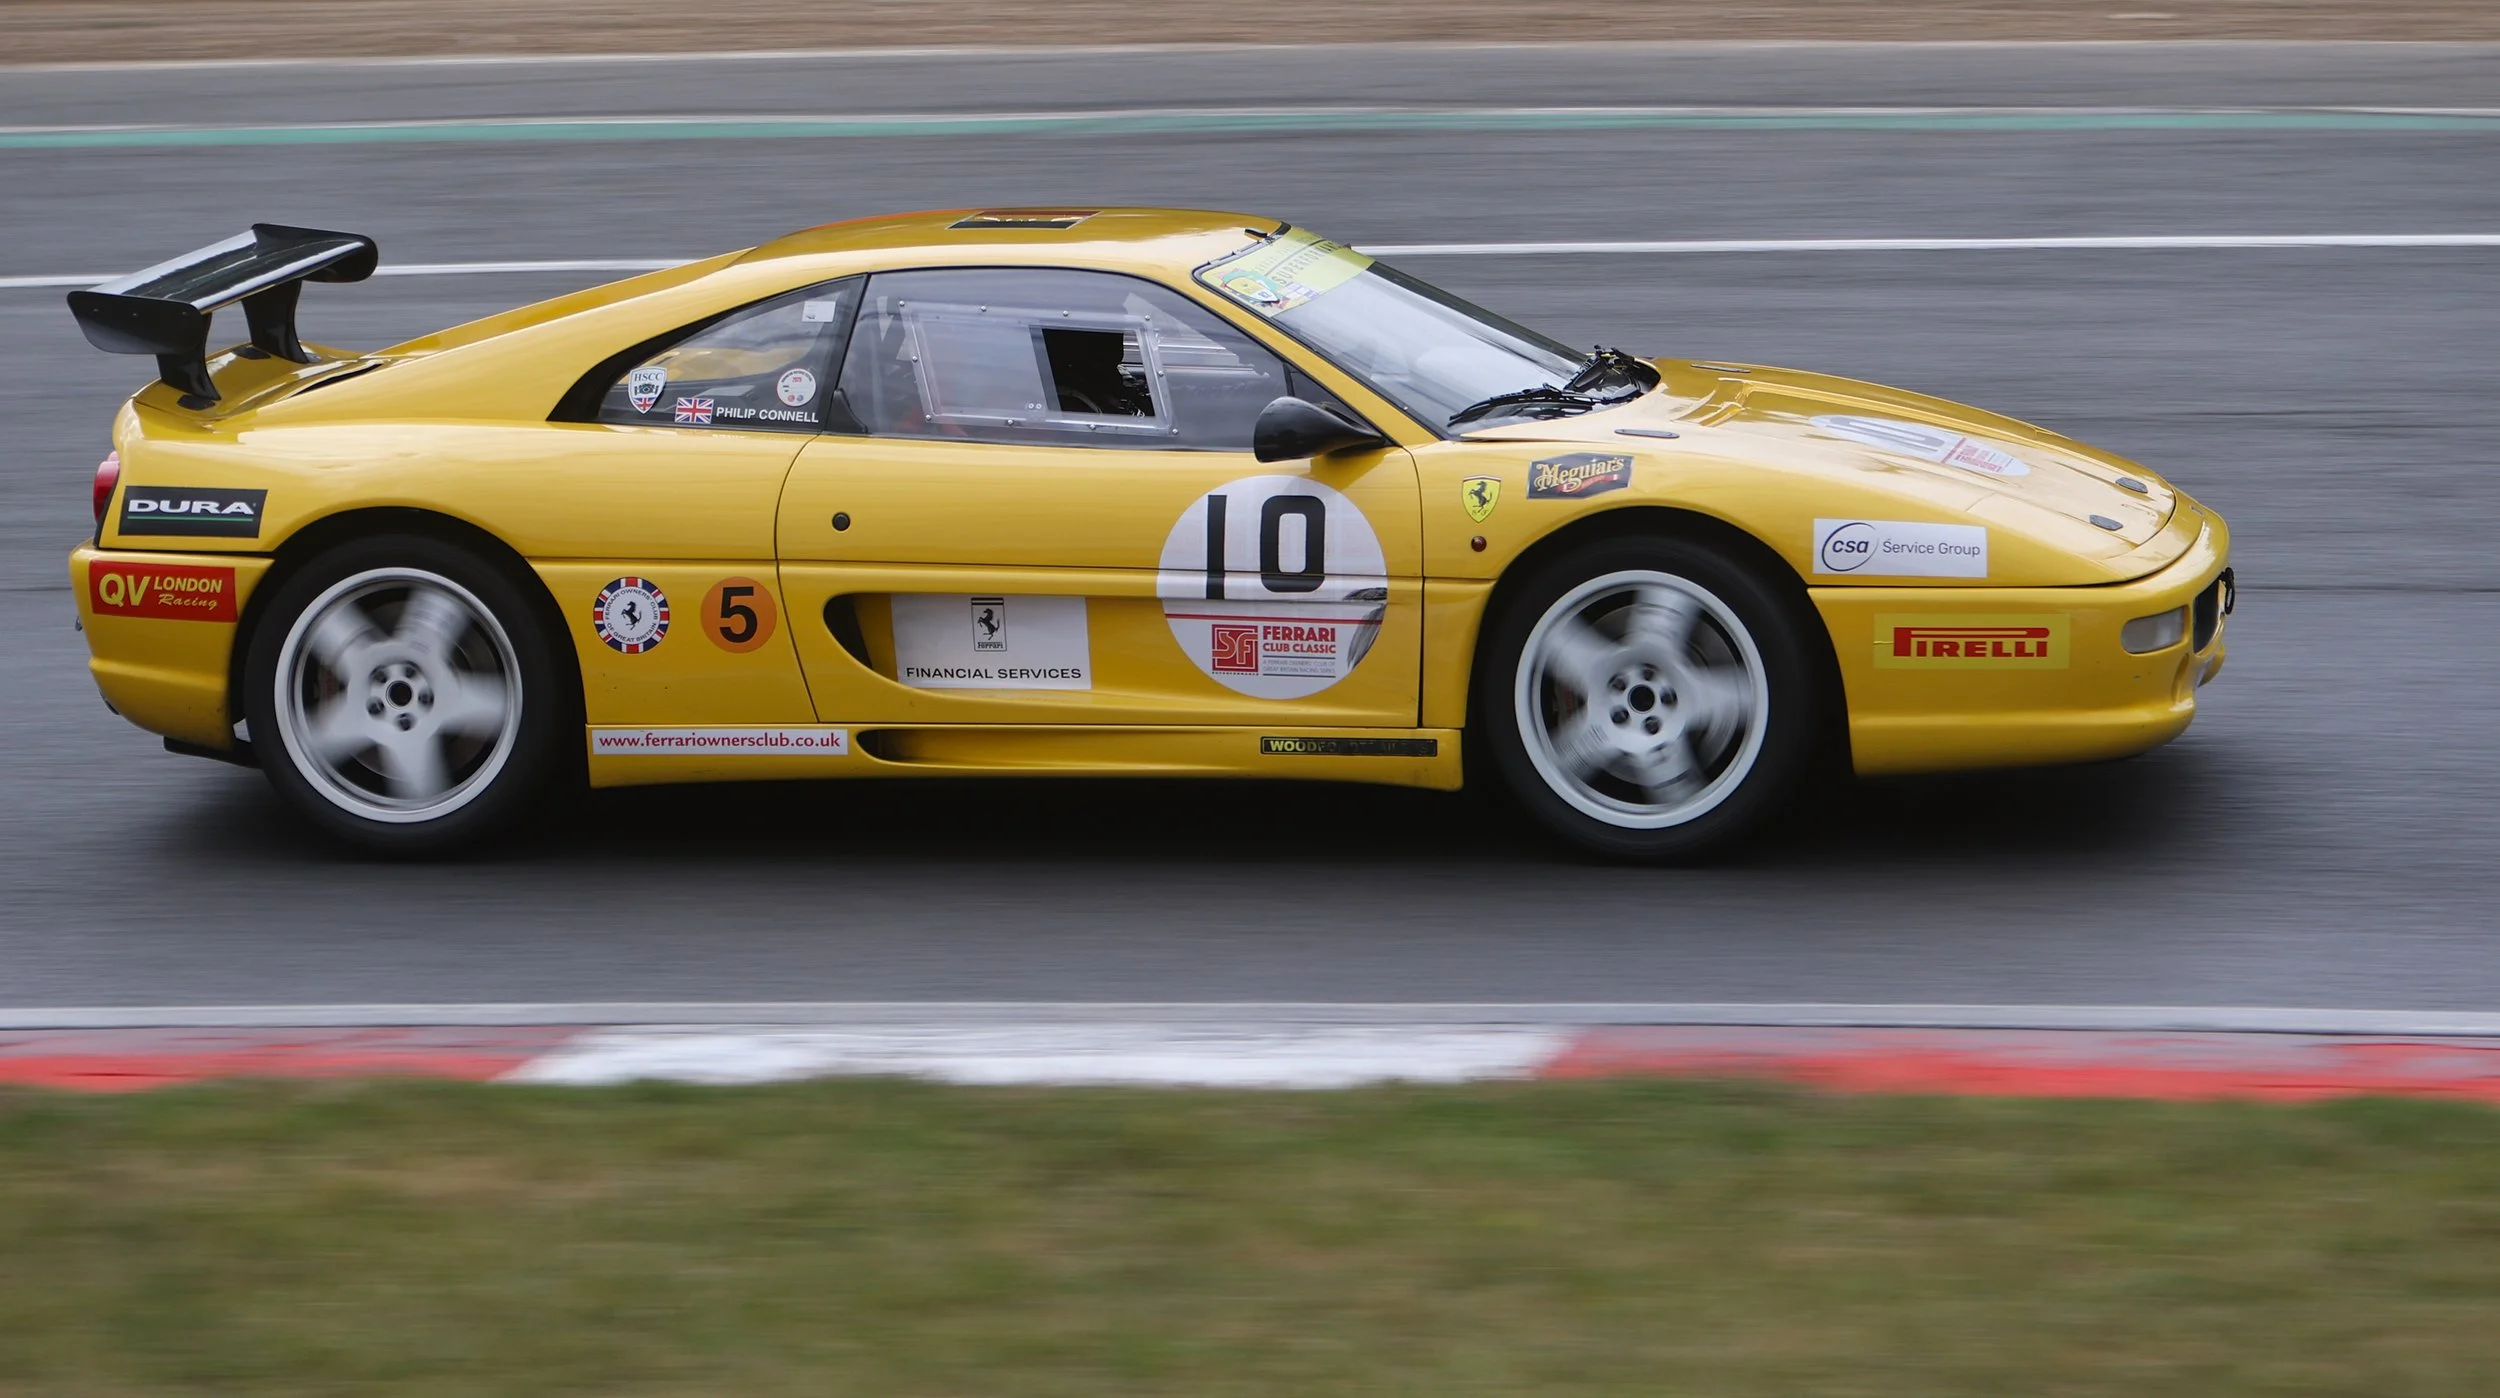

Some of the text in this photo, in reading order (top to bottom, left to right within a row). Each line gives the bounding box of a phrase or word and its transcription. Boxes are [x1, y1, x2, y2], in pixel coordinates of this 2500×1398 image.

[634, 372, 664, 381] HSCC
[716, 407, 819, 423] PHILIP CONNELL
[1534, 457, 1625, 493] Meguiar's
[128, 499, 254, 515] DURA
[1206, 495, 1326, 600] 10
[1832, 539, 1981, 558] csa Service Group
[99, 573, 151, 607] QV
[153, 576, 223, 594] LONDON
[158, 593, 218, 611] Racing
[605, 592, 620, 620] FERRARI
[650, 601, 659, 620] CLUB
[719, 586, 758, 644] 5
[606, 622, 657, 643] OF GREAT BRITAIN
[1262, 625, 1336, 642] FERRARI
[1262, 642, 1336, 653] CLUB CLASSIC
[1893, 627, 2050, 658] PIRELLI
[906, 667, 1082, 679] FINANCIAL SERVICES
[600, 733, 840, 748] www.ferrariownersclub.co.uk
